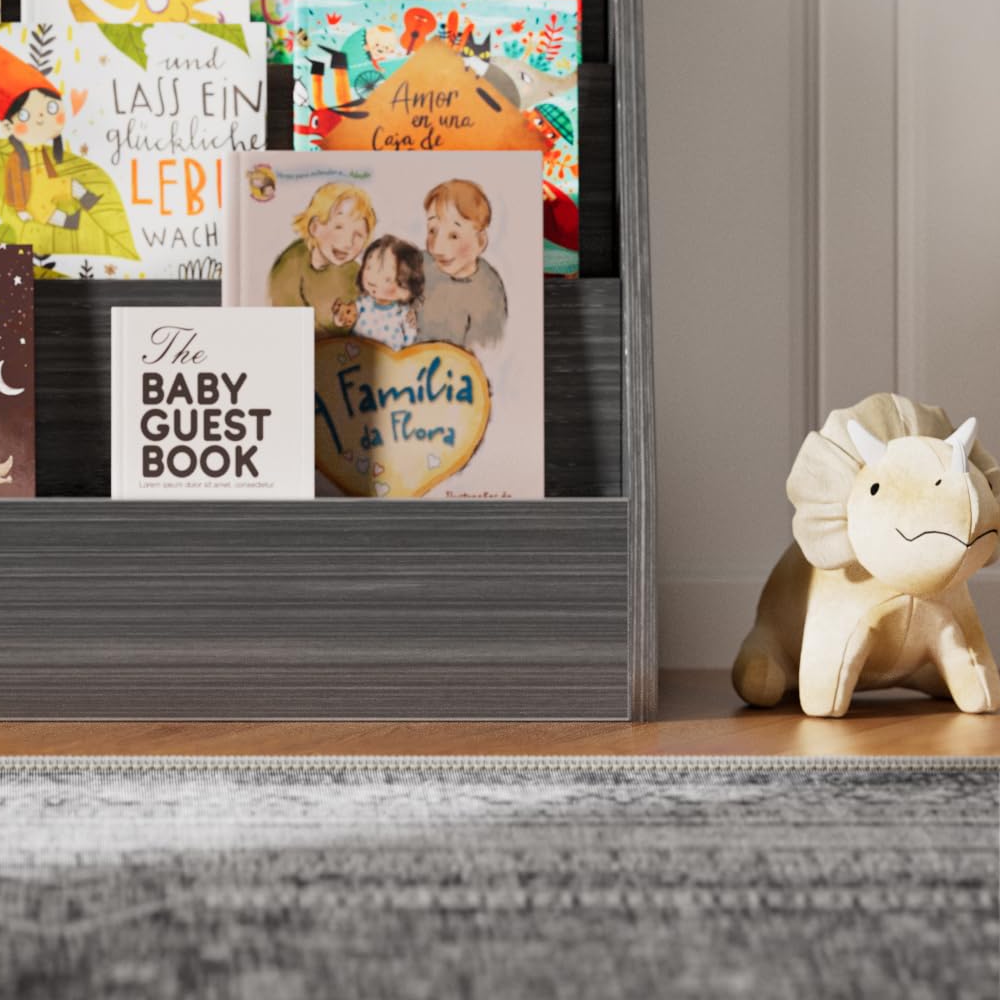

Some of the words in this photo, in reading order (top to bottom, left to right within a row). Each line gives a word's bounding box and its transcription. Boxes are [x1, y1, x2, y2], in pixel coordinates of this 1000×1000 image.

[164, 46, 224, 71] und
[112, 76, 181, 118] LASS
[391, 79, 460, 114] Amor
[411, 112, 433, 129] en
[438, 114, 476, 129] una
[106, 116, 266, 166] glückliche
[371, 126, 416, 150] Caja
[419, 127, 445, 149] de
[141, 222, 218, 249] WACH
[141, 325, 208, 365] The
[142, 372, 248, 405] BABY
[337, 356, 475, 418] Família
[140, 408, 272, 441] GUEST
[360, 424, 384, 449] da
[390, 409, 456, 446] Flora
[142, 445, 260, 478] BOOK
